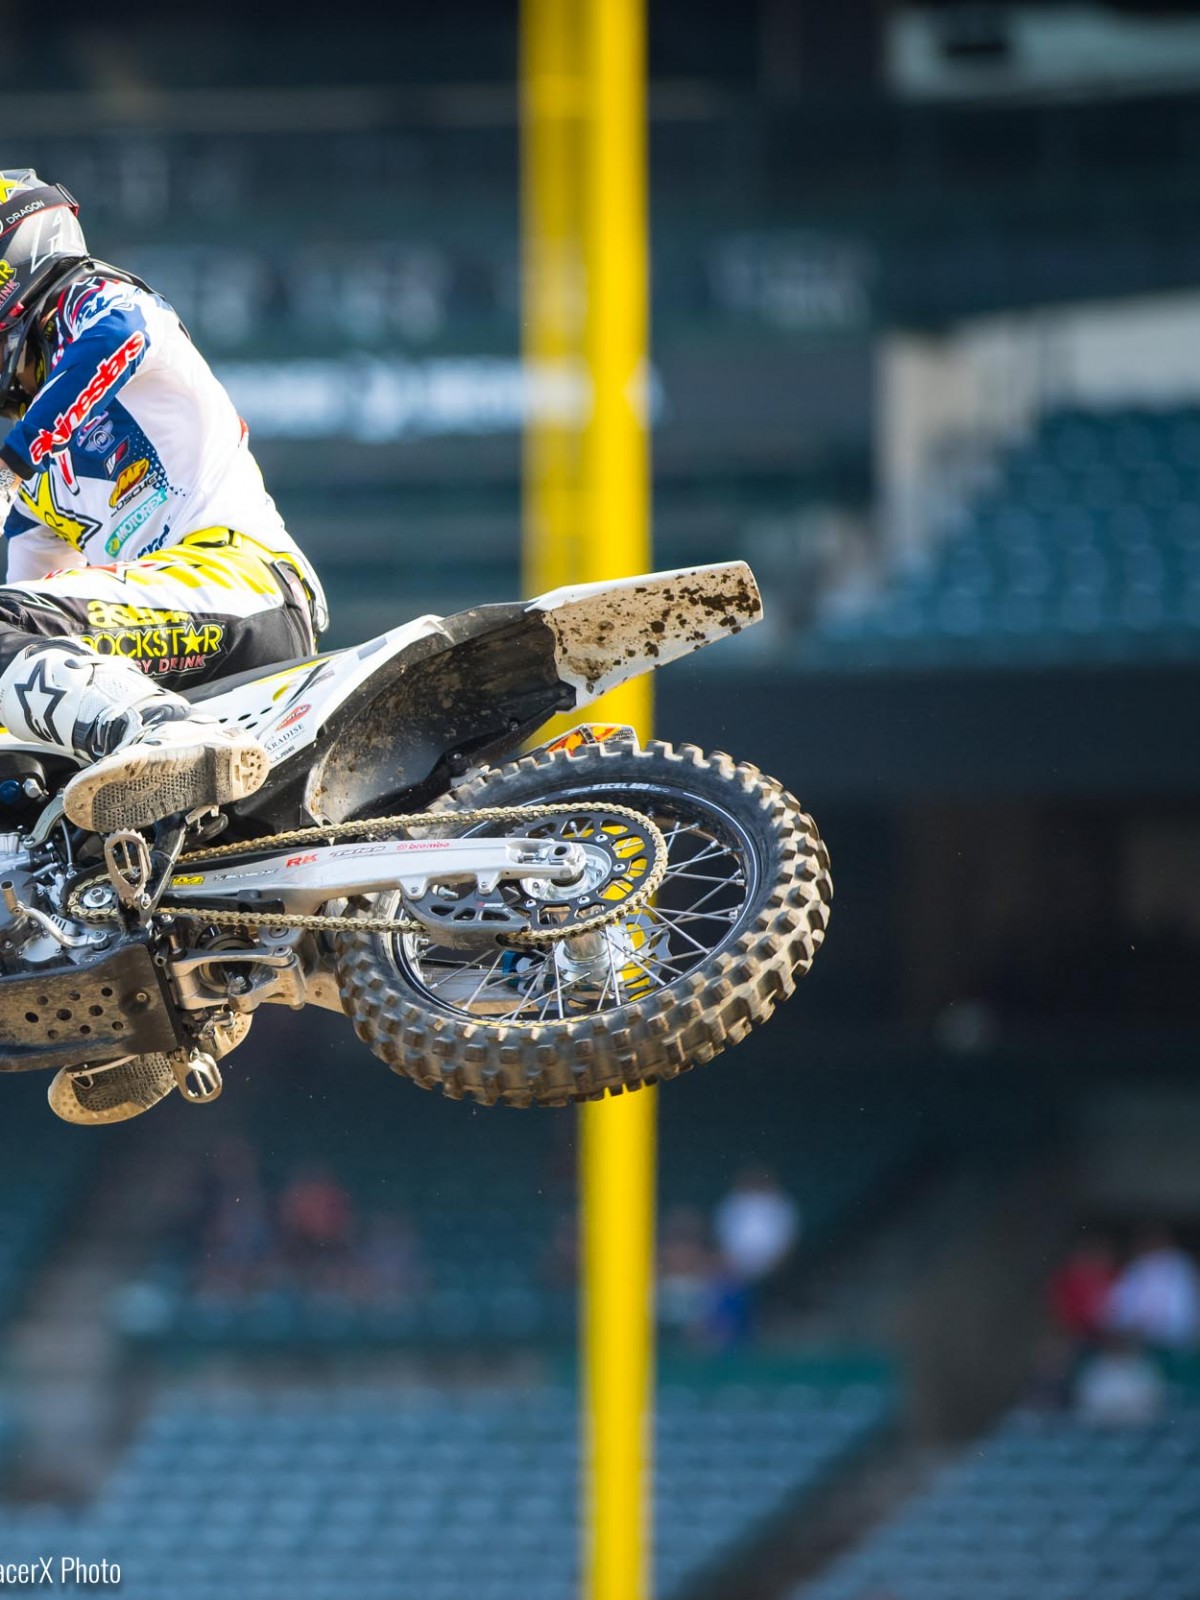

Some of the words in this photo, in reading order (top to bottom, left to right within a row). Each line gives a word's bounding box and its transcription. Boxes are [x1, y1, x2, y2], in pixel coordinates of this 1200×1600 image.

[6, 200, 46, 225] DRAGON
[116, 494, 164, 542] MOTOREX
[159, 655, 205, 673] DRINK
[285, 853, 319, 868] RK
